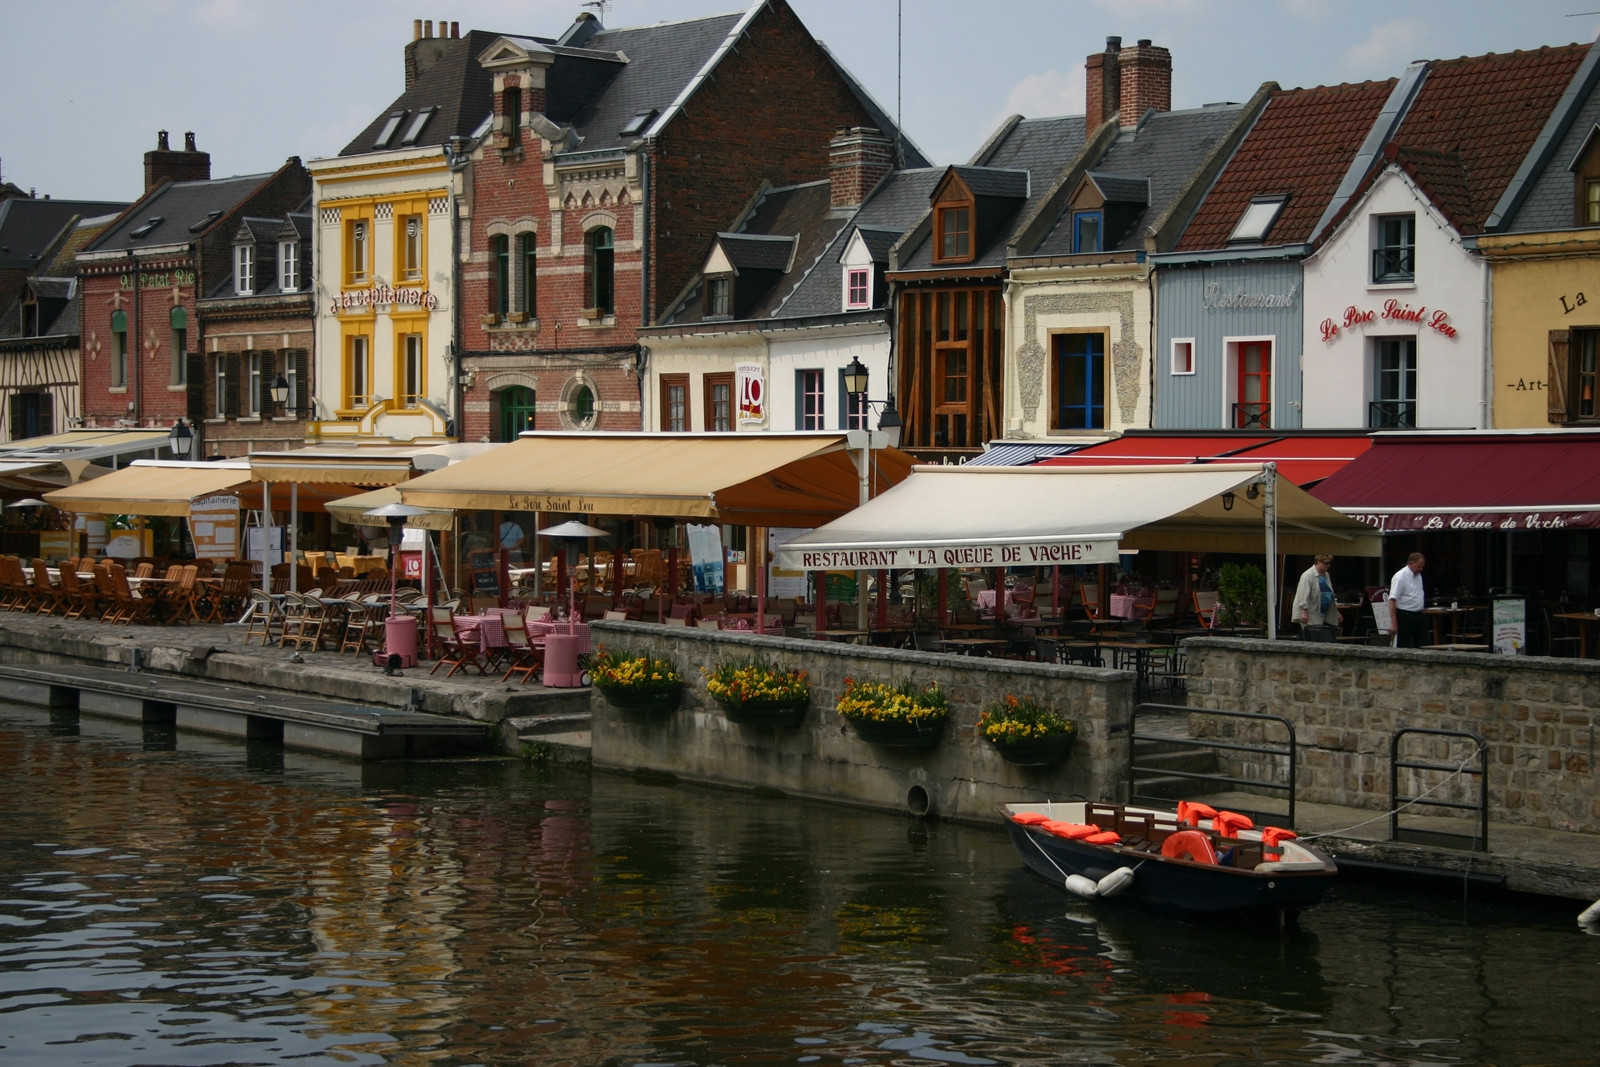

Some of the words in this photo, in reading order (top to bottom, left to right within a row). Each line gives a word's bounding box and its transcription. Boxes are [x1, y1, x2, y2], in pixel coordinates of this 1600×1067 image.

[340, 291, 352, 310] la
[357, 284, 438, 310] capitainerie
[1203, 282, 1297, 309] Restaurant
[1559, 291, 1587, 314] La
[1320, 318, 1338, 342] Le
[1343, 305, 1375, 328] Porc
[1381, 299, 1425, 323] Saint
[1428, 310, 1457, 338] Leu
[509, 494, 519, 509] Le
[546, 497, 571, 511] Saint
[577, 497, 594, 511] Leu
[1450, 516, 1492, 529] Queue
[1500, 517, 1516, 529] de
[803, 550, 898, 567] RESTAURANT
[943, 547, 994, 565] QUEUE
[1001, 546, 1022, 563] DE
